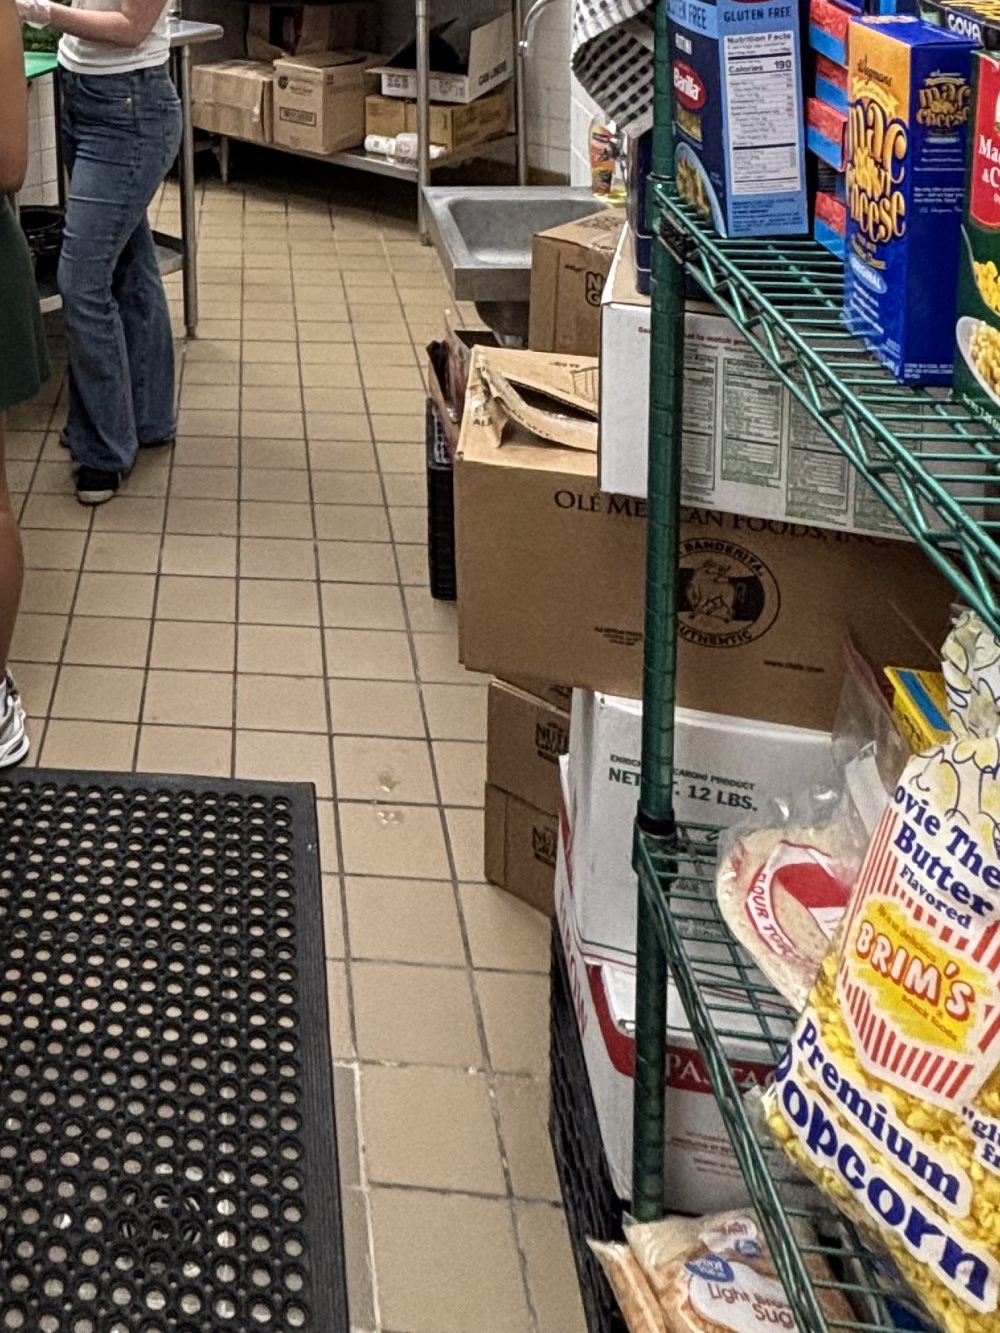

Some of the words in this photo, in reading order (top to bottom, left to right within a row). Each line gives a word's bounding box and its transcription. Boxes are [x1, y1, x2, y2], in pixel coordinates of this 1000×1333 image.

[688, 3, 707, 30] FREE
[723, 8, 764, 23] GLUTEN
[768, 5, 792, 19] FREE
[948, 13, 982, 42] GOYA
[727, 35, 766, 44] Nutrition
[767, 32, 792, 42] Facts
[728, 65, 764, 73] Calories
[773, 59, 792, 70] 190
[673, 66, 702, 101] Barilla
[978, 133, 1000, 166] Ma
[684, 539, 765, 575] BANDERITA
[678, 625, 753, 646] UTHENTIC
[610, 753, 641, 767] ENRIC
[674, 767, 708, 781] CARONI
[710, 774, 755, 791] PRODUCT
[608, 767, 641, 787] NET
[687, 784, 712, 802] 12
[716, 789, 758, 812] LBS.
[893, 820, 995, 917] Butter
[899, 864, 973, 930] Flavored
[856, 919, 976, 1023] BRIM'S
[797, 1016, 961, 1205] Premium
[707, 1282, 752, 1304] Light
